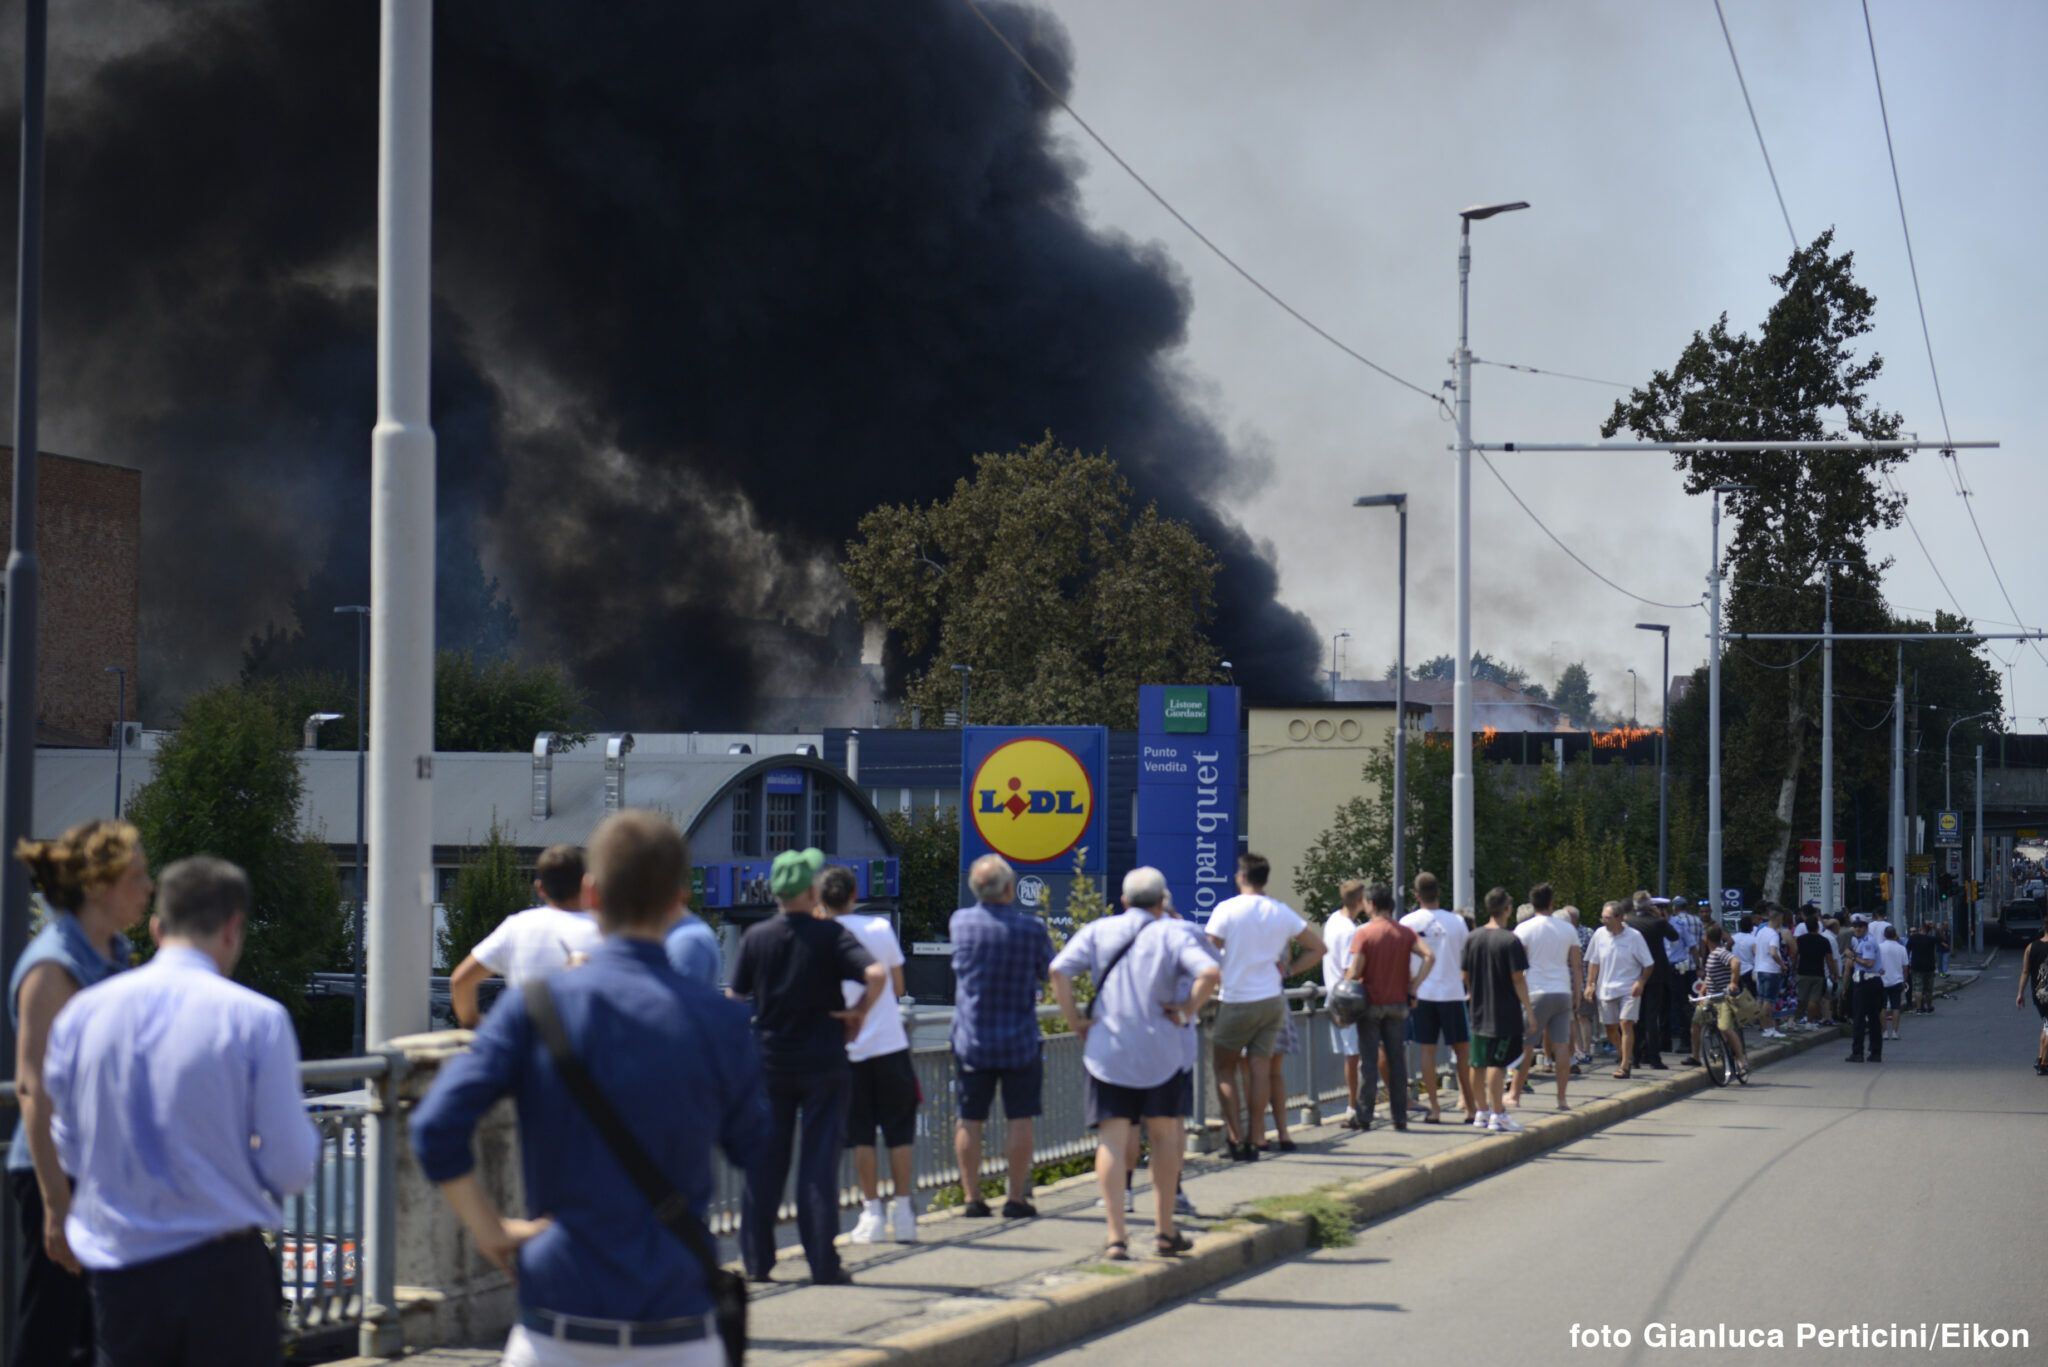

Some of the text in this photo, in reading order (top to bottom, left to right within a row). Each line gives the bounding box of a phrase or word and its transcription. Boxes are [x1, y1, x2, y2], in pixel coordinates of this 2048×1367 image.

[1170, 699, 1203, 709] Listone
[1164, 708, 1206, 718] Giordano
[1144, 746, 1177, 757] Punto
[1144, 760, 1187, 772] Vendita
[979, 776, 1083, 820] LIDL
